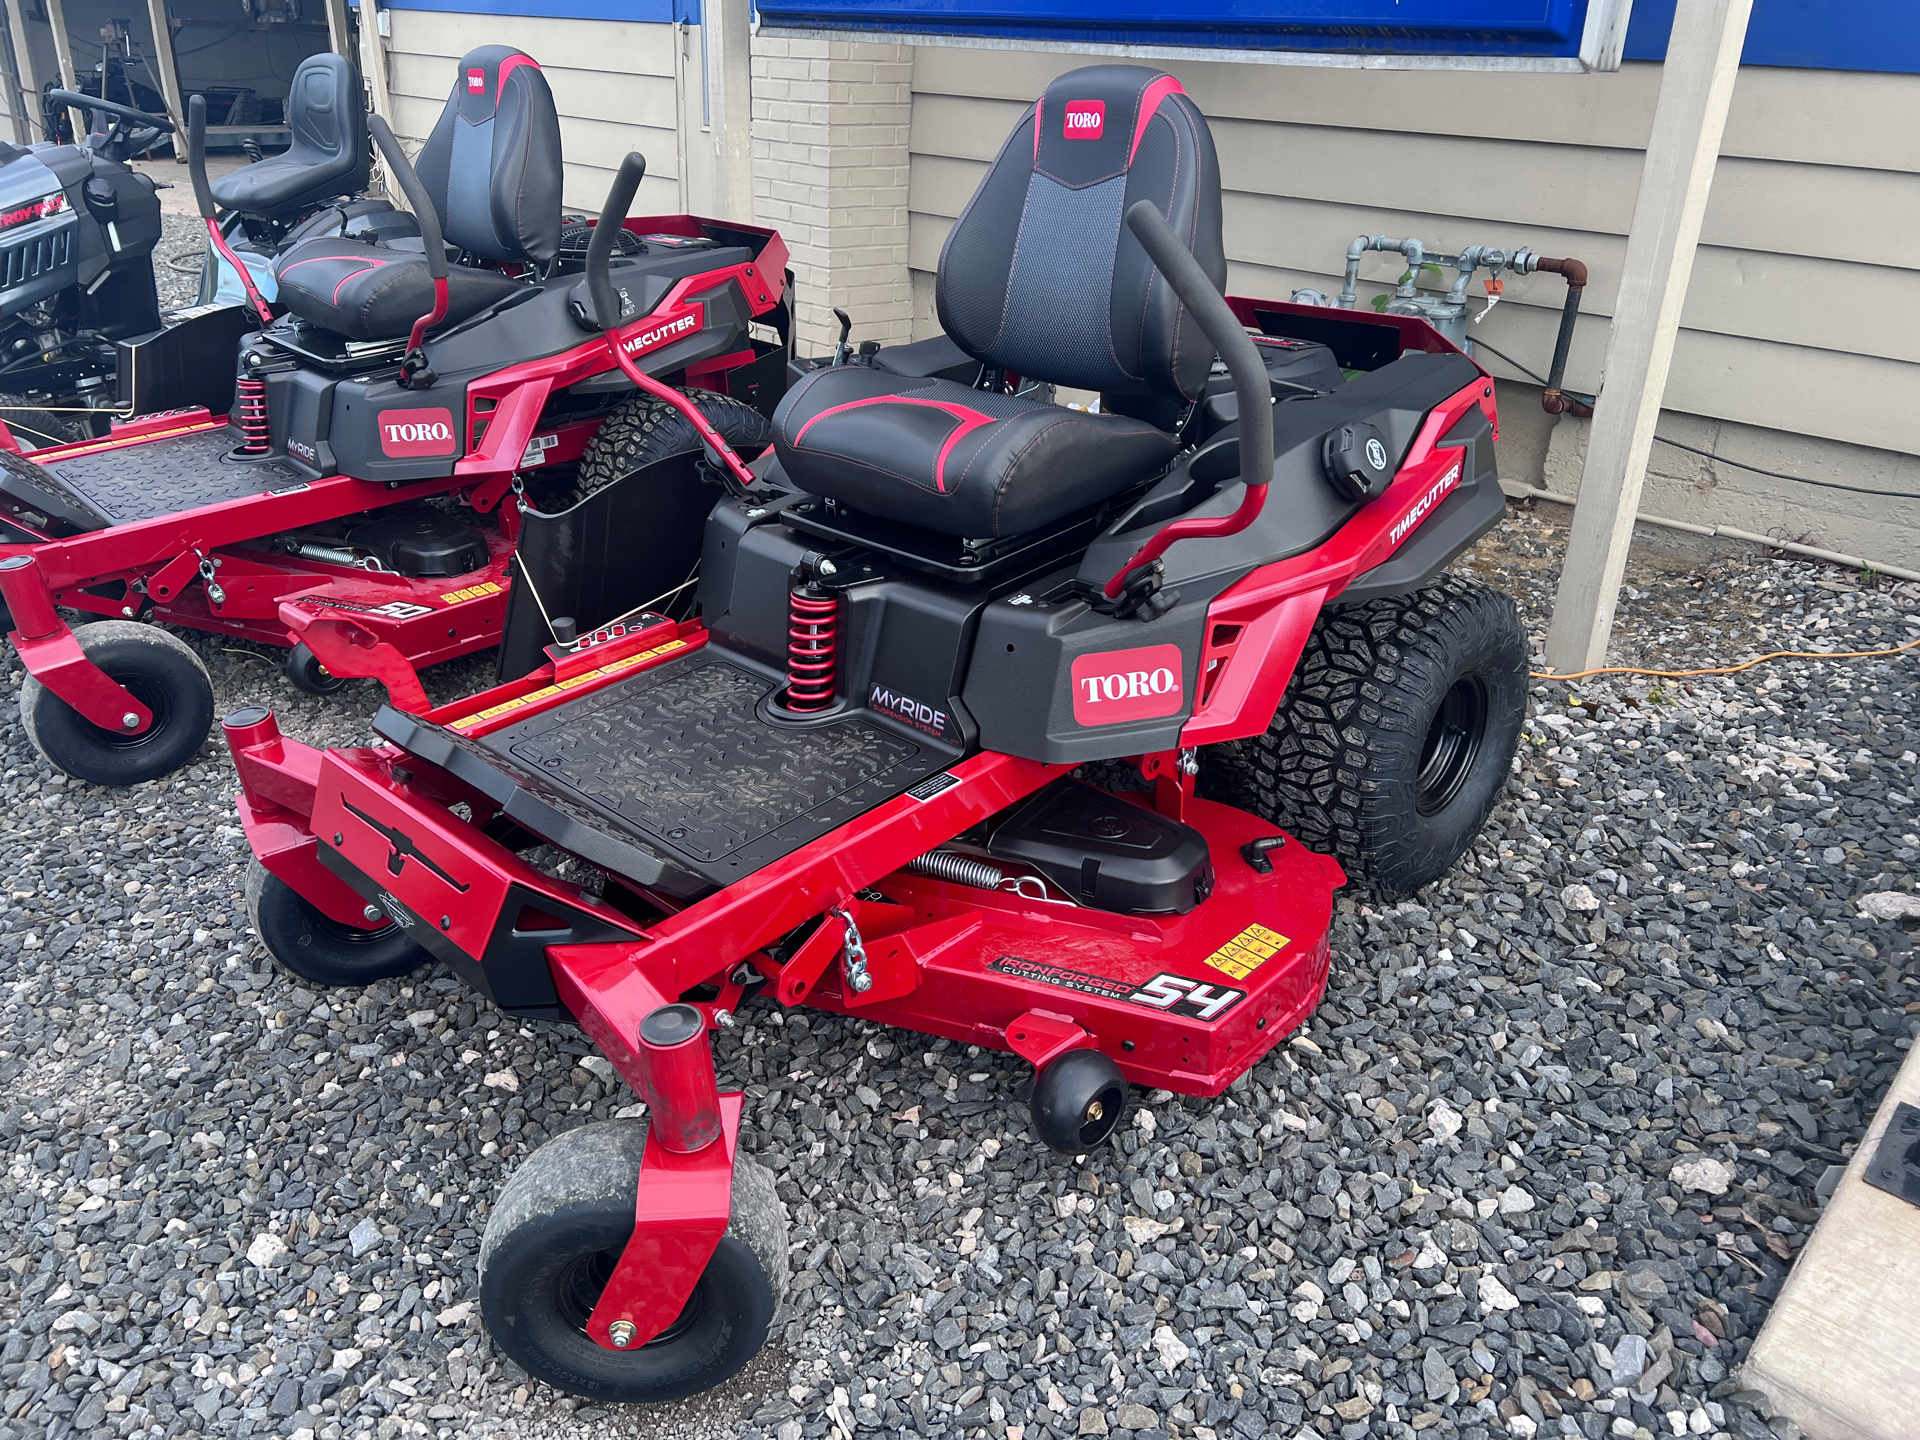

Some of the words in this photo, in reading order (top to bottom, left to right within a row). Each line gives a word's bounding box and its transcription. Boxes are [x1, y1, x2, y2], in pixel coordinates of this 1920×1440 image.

[468, 76, 484, 87] TORO
[1066, 112, 1101, 128] TORO
[622, 315, 696, 353] MECUTTER
[385, 422, 449, 442] TORO
[1389, 463, 1460, 546] TIMECUTTER
[368, 601, 432, 620] 50
[1081, 667, 1175, 703] TORO
[873, 704, 913, 726] SUSPENSION
[915, 722, 942, 737] SYSTEM
[999, 956, 1132, 994] IRONFORGED
[1002, 966, 1060, 985] CUTTING
[1065, 981, 1121, 999] SYSTEM
[1130, 974, 1241, 1020] 54
